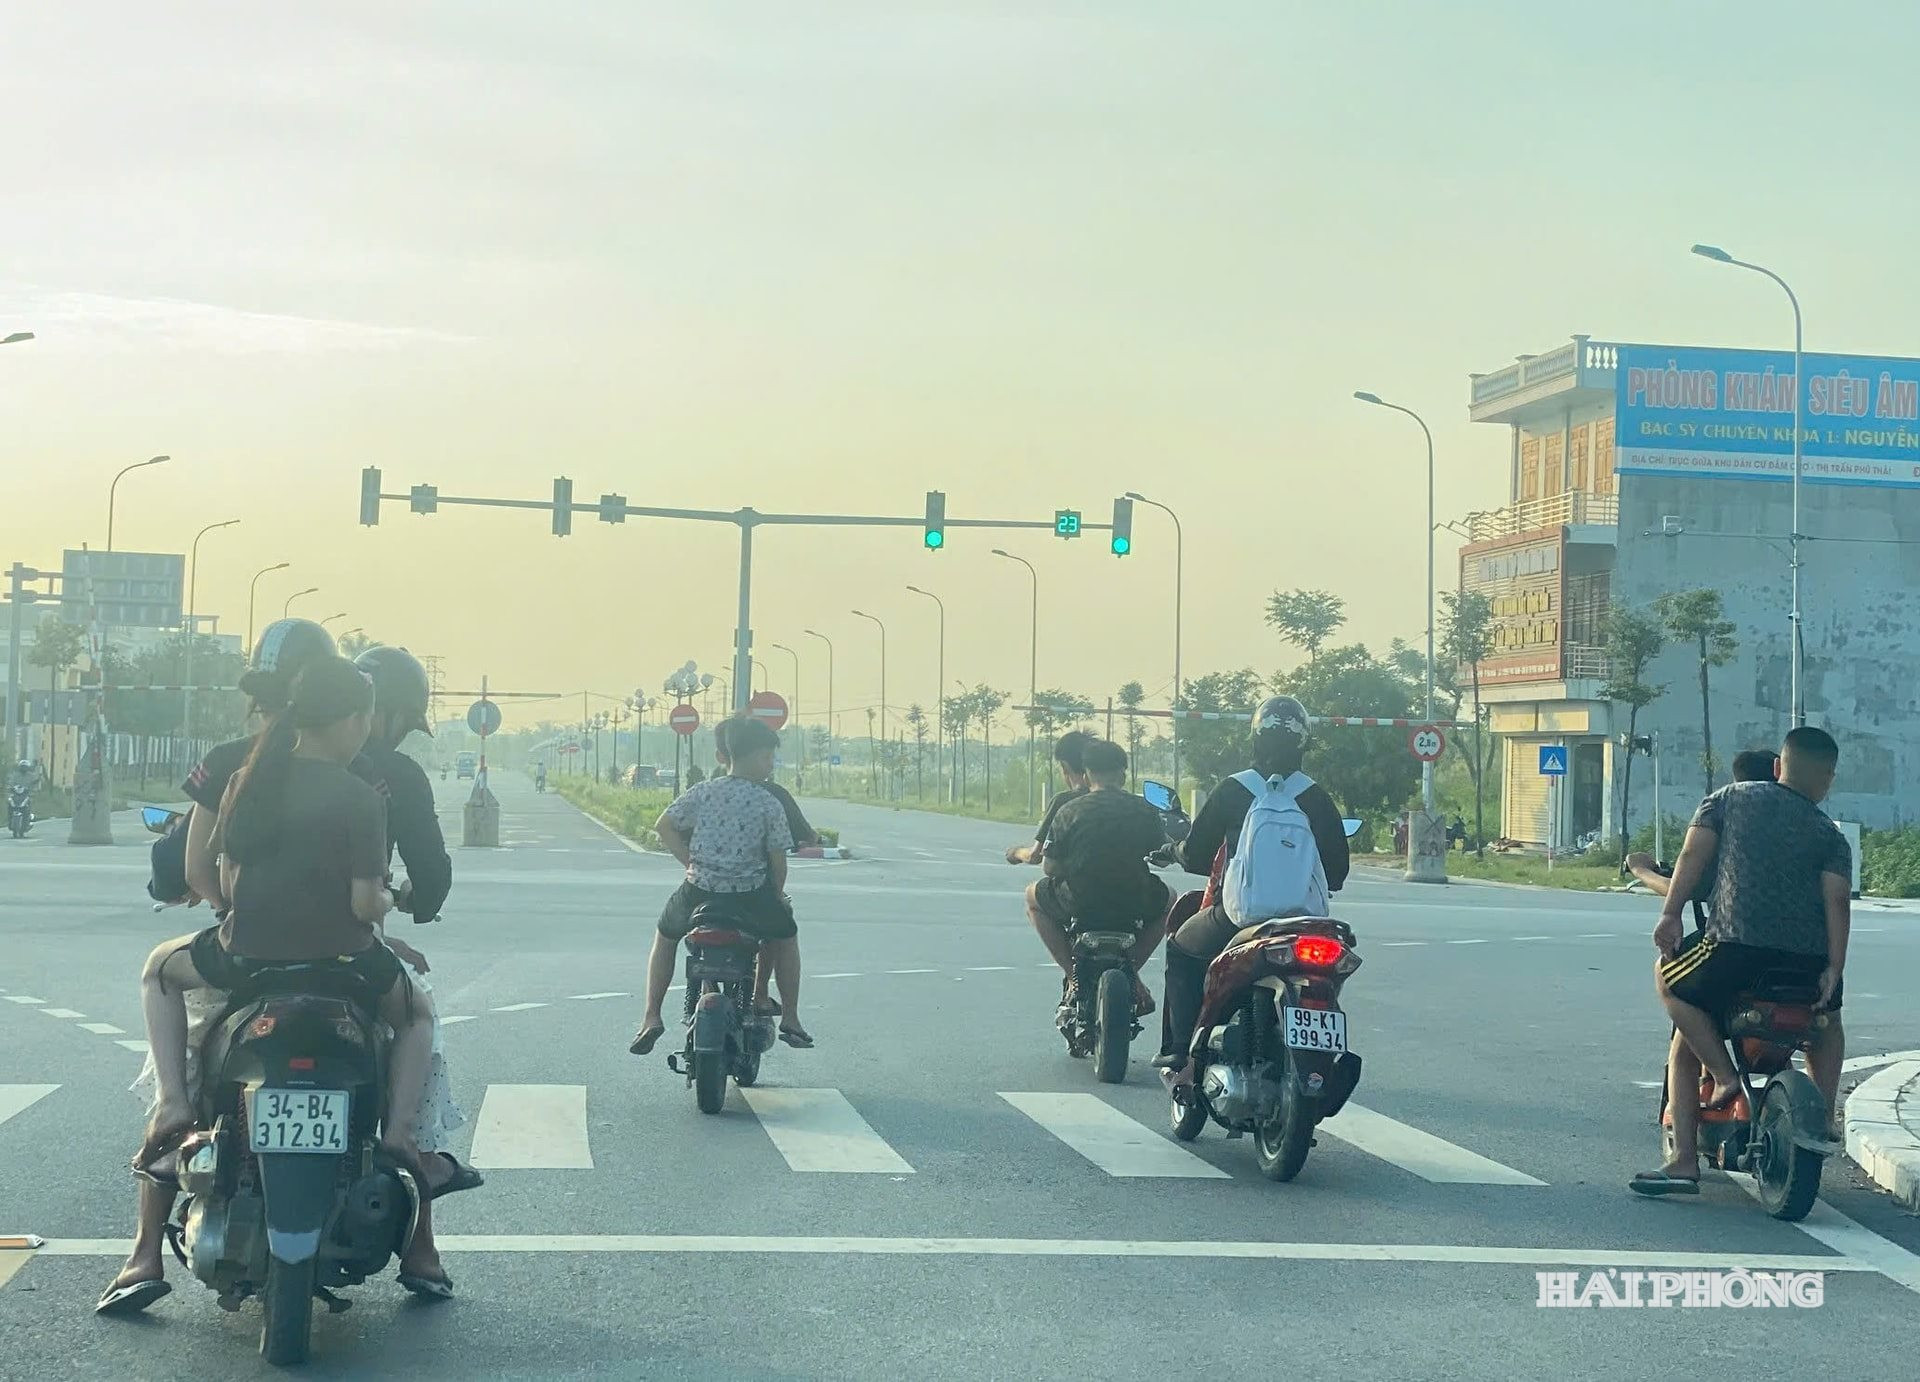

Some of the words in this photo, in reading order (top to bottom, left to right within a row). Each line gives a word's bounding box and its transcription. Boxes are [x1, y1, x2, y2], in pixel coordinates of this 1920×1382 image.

[1627, 359, 1718, 411] PHÒNG
[1724, 365, 1797, 413] KHÁM
[1808, 368, 1869, 417] SIÊU
[1874, 371, 1918, 420] ÂM
[1845, 424, 1919, 448] NGUYỄN
[1058, 515, 1078, 533] 23
[1294, 1009, 1336, 1030] 99-K1
[1289, 1028, 1343, 1051] 399.34
[268, 1094, 333, 1120] 34-B4
[257, 1122, 341, 1148] 312.94
